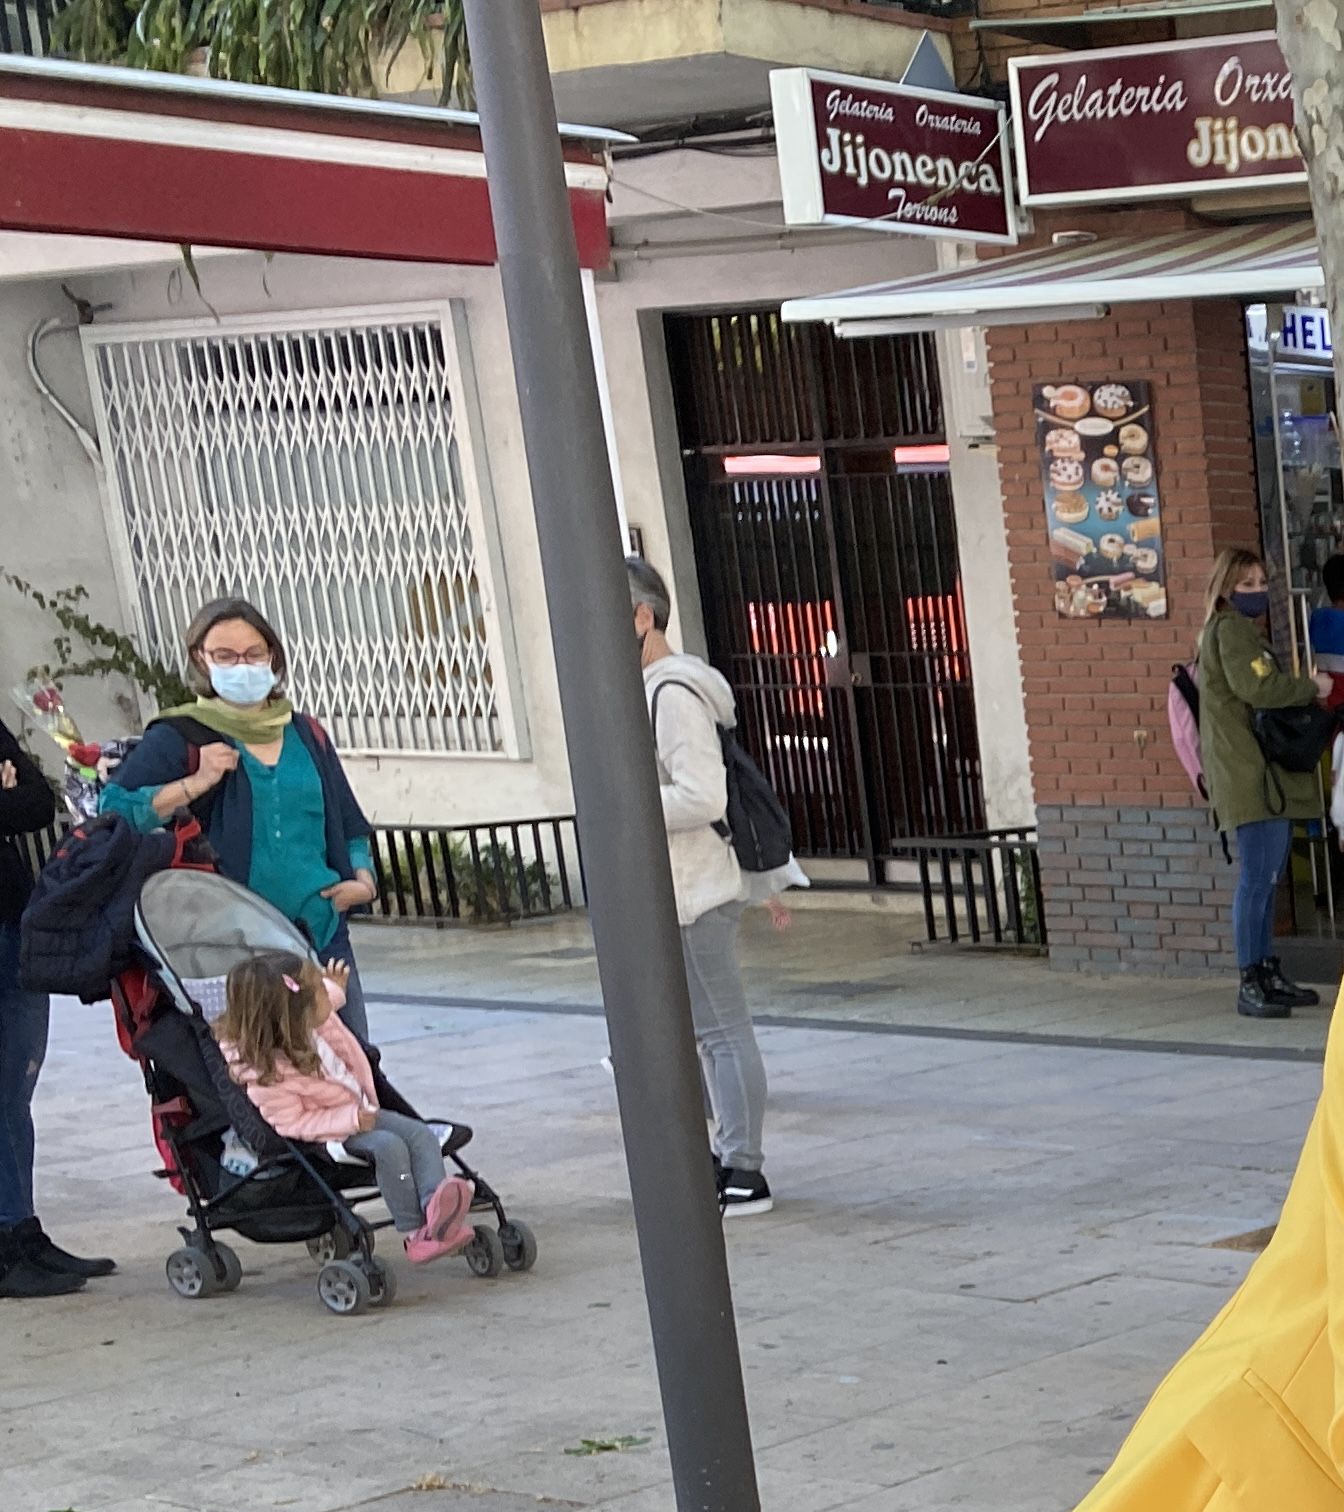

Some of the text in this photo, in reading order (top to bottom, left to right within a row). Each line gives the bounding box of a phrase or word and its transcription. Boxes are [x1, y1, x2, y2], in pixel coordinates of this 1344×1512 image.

[826, 89, 982, 136] Gelateria Orxateria
[1028, 72, 1188, 142] Gelateria
[821, 127, 1001, 194] Jijonenca
[888, 187, 959, 224] Torrons
